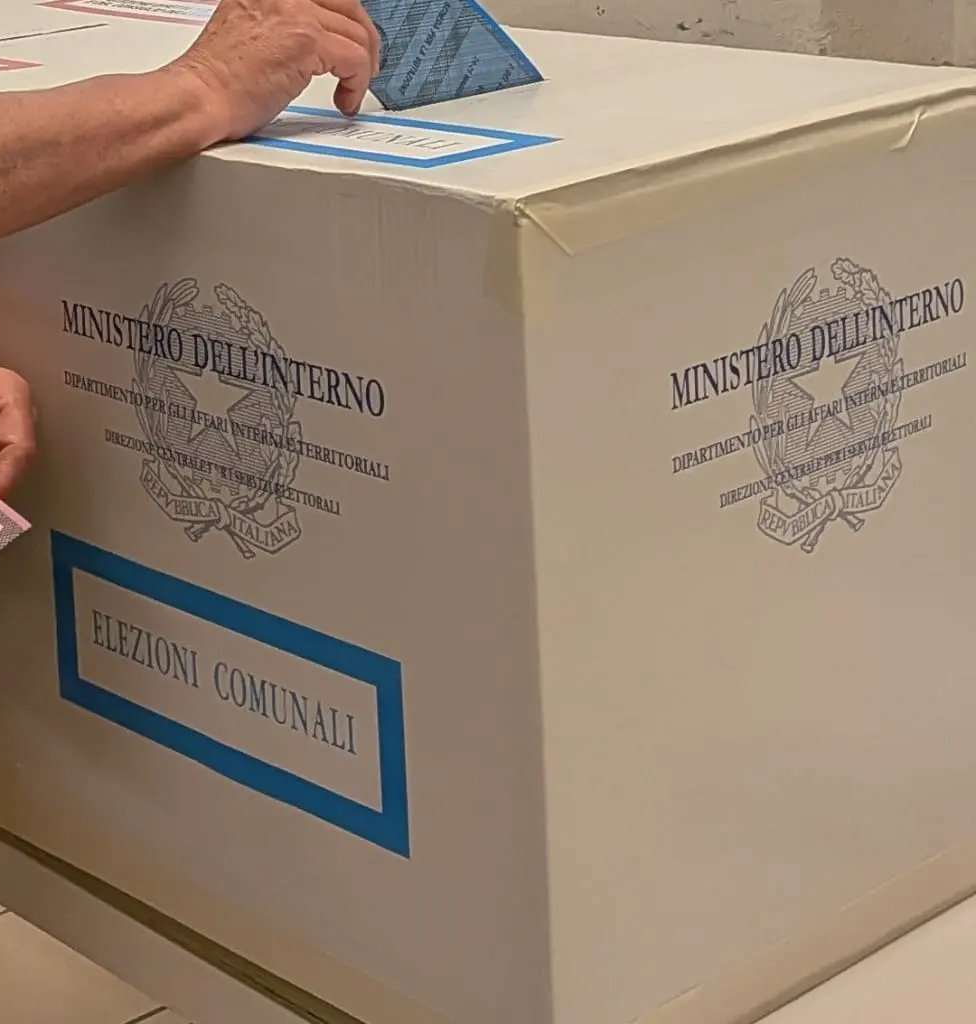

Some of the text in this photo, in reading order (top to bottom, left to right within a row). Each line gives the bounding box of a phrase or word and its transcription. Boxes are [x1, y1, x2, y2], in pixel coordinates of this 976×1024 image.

[60, 299, 385, 417] MINISTERO DELL'INTERNO
[670, 277, 965, 411] MINISTERO DELL'INTERNO
[63, 370, 143, 407] DIPARTIMENTO
[144, 395, 167, 416] PER
[189, 408, 229, 434] AFFARI
[296, 439, 391, 482] TERRITORIALI
[104, 428, 156, 456] DIREZIONE
[672, 427, 762, 474] DIPARTIMENTO
[762, 419, 785, 441] PER
[808, 398, 844, 425] AFFARI
[899, 351, 967, 390] TERRITORIALI
[231, 514, 299, 547] ITALIANA
[719, 475, 773, 509] DIREZIONE
[844, 462, 900, 509] ITALIANA
[91, 609, 357, 756] ELEZIONI COMUNALI
